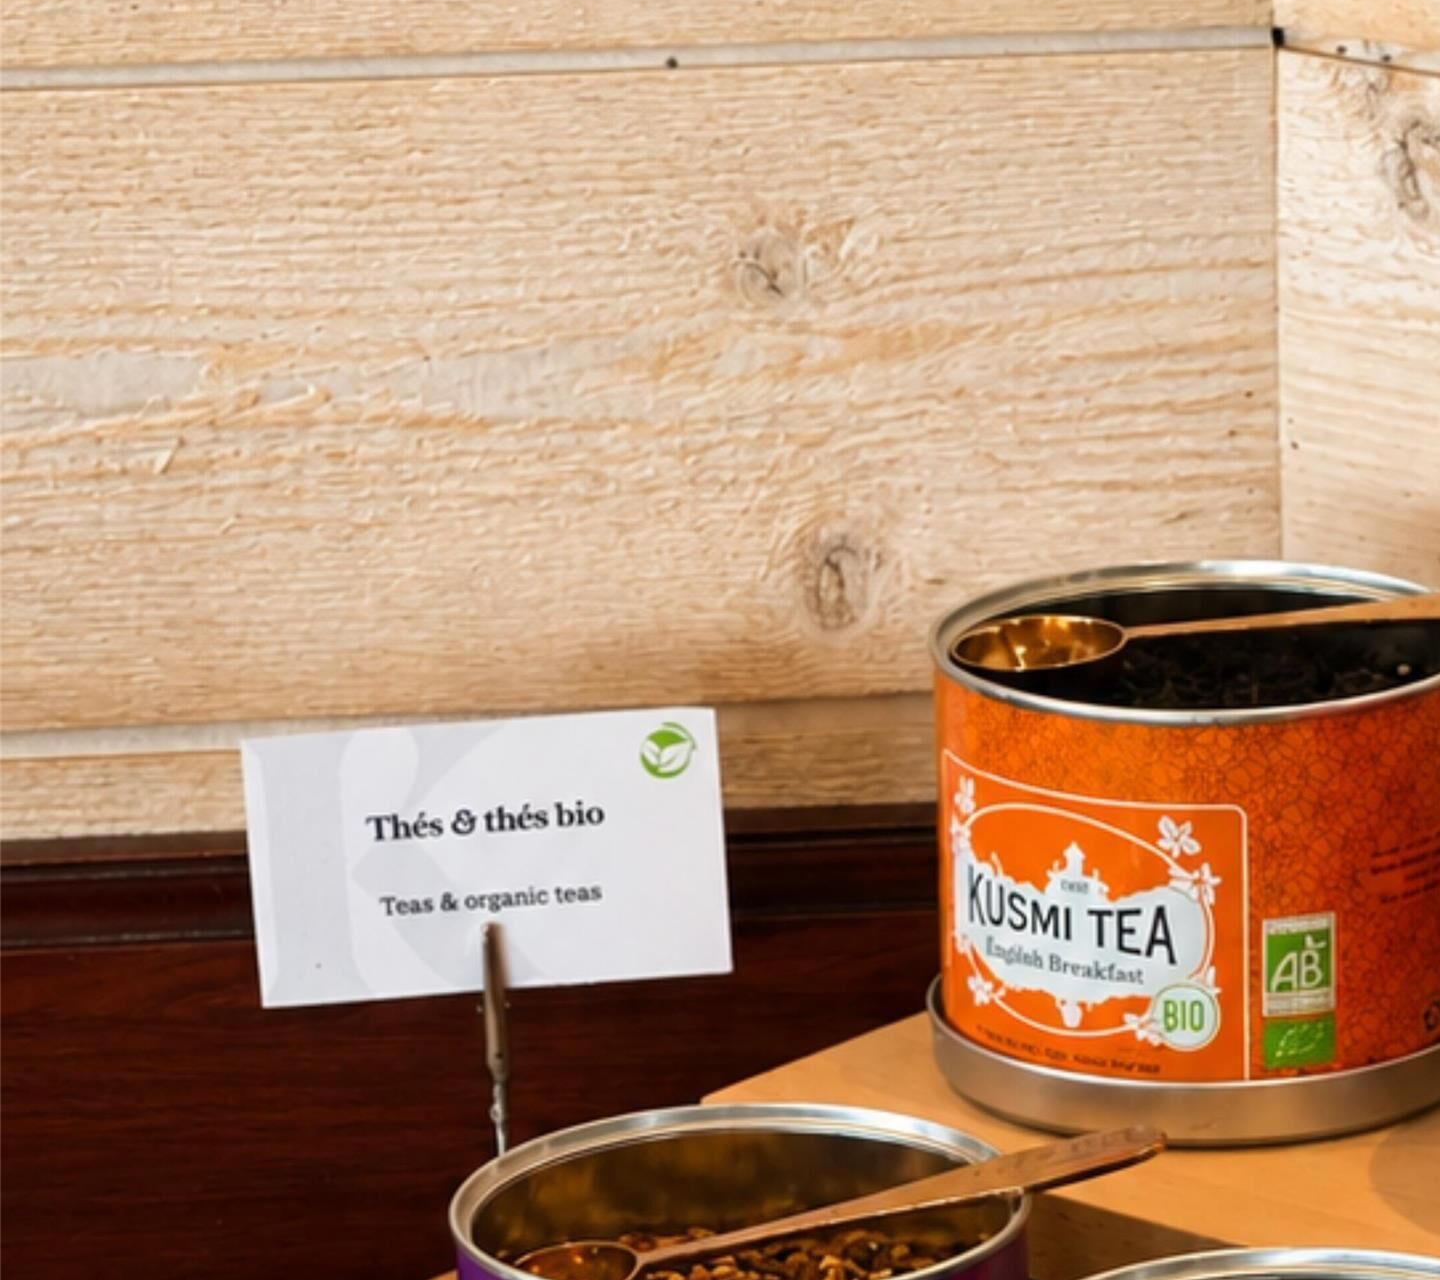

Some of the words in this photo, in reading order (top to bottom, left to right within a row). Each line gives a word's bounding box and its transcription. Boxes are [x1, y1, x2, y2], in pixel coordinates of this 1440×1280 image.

[366, 811, 444, 843] Thés
[451, 809, 478, 836] &
[484, 804, 550, 833] thés
[555, 800, 606, 828] bio
[379, 896, 434, 917] Teas
[440, 891, 460, 912] &
[464, 885, 550, 914] organic
[554, 885, 604, 904] teas
[967, 864, 1072, 942] KUSMI
[1087, 904, 1178, 967] TEA
[985, 935, 1045, 968] English
[1049, 953, 1145, 986] Breakfast
[1269, 948, 1324, 993] AB
[1162, 999, 1206, 1034] BIO
